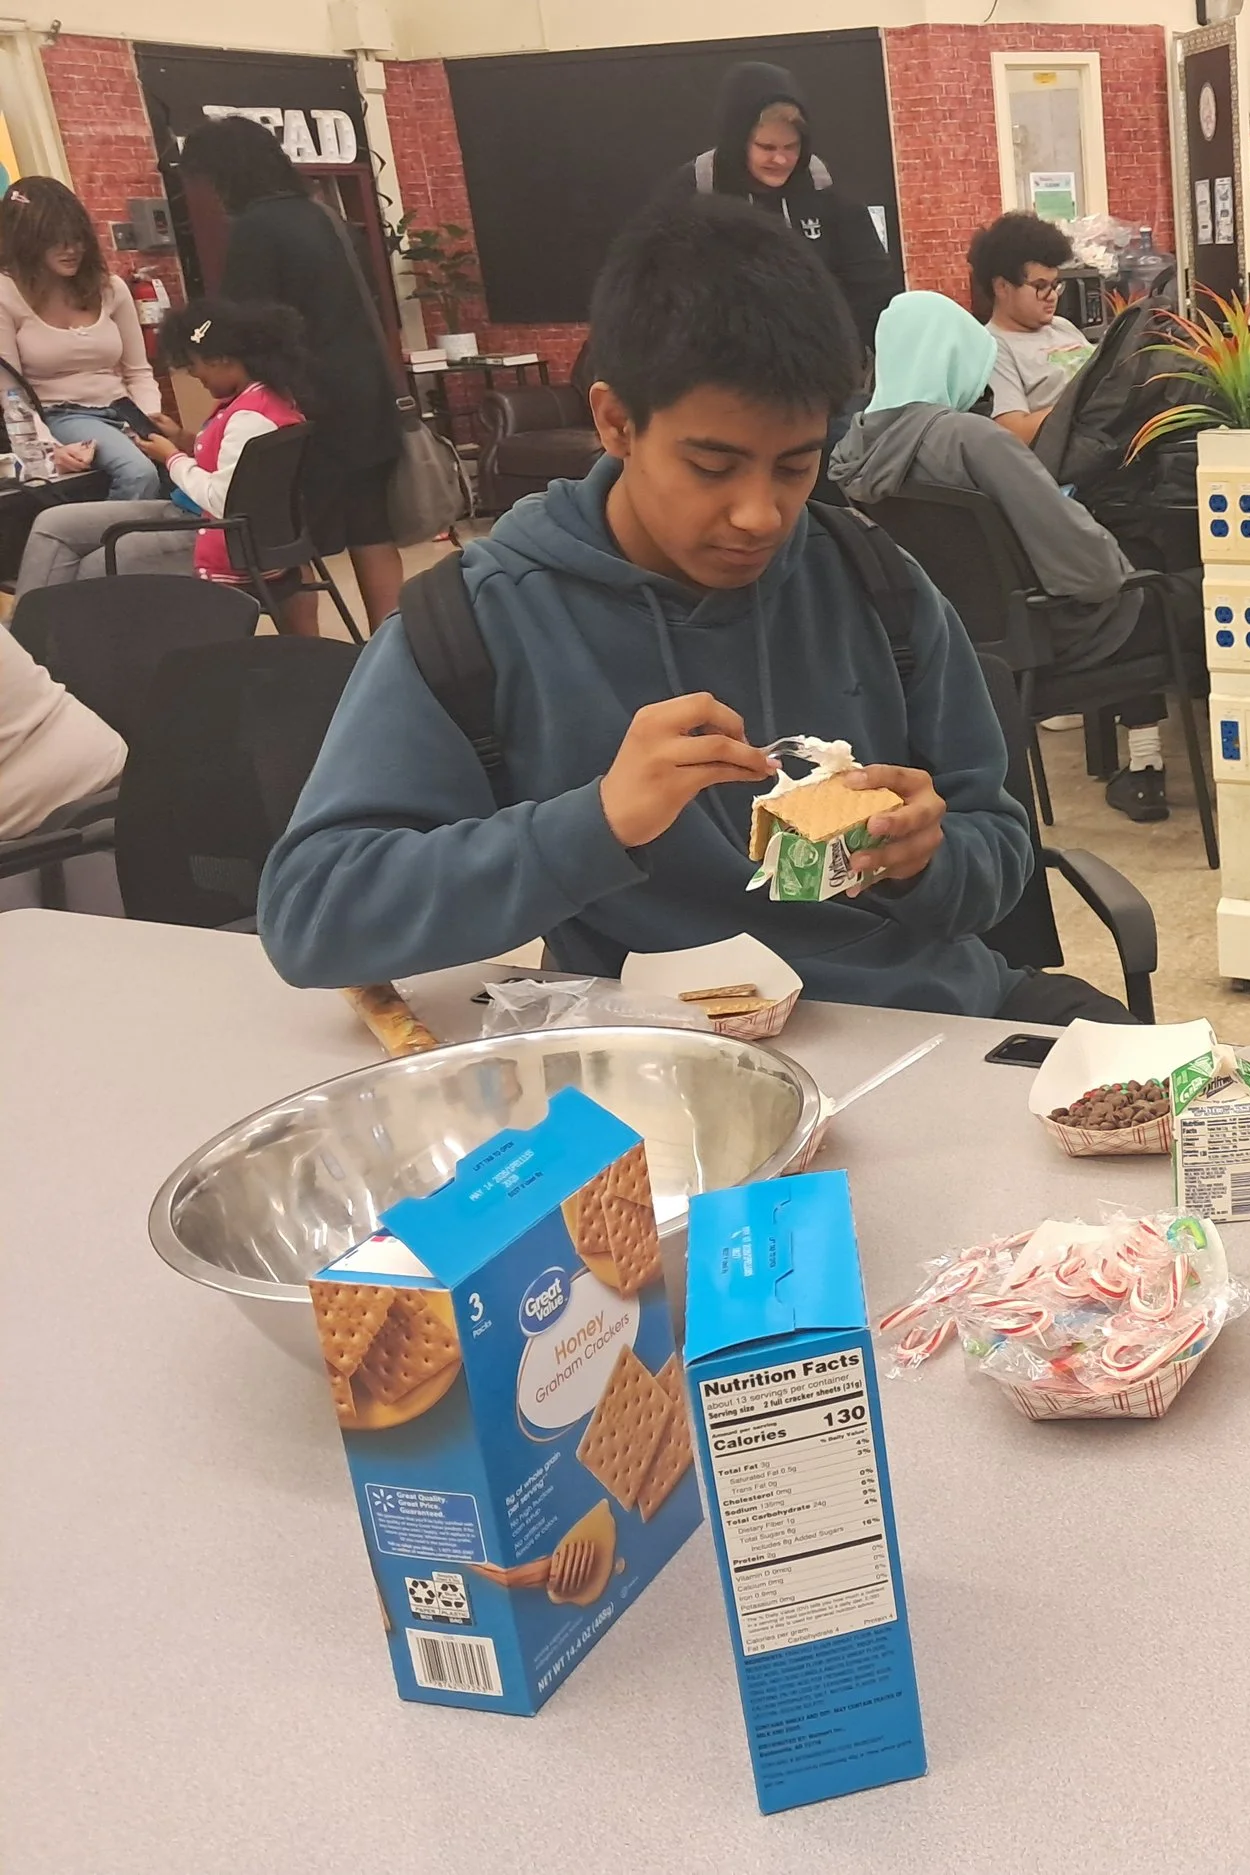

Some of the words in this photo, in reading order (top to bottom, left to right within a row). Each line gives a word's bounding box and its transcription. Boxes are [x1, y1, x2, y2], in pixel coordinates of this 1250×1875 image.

[202, 104, 357, 163] AD
[525, 1278, 562, 1317] Great
[468, 1293, 483, 1322] 3
[473, 1319, 492, 1339] Packs
[554, 1310, 604, 1364] Honey
[535, 1357, 583, 1403] Graham
[584, 1313, 629, 1360] Crackers
[704, 1368, 796, 1397] Nutrition
[802, 1354, 860, 1377] Facts
[707, 1400, 733, 1411] about
[736, 1396, 747, 1404] 13
[749, 1388, 788, 1402] servings
[791, 1384, 805, 1394] per
[808, 1374, 849, 1389] container
[708, 1409, 737, 1420] Serving
[740, 1405, 755, 1413] size
[770, 1397, 783, 1407] full
[785, 1392, 814, 1404] cracker
[816, 1386, 841, 1398] sheets
[843, 1379, 862, 1392] (31g)
[823, 1405, 866, 1427] 130
[713, 1428, 787, 1451] Calories
[828, 1435, 844, 1443] Daily
[857, 1448, 871, 1456] 3%
[523, 1468, 544, 1488] whole
[544, 1451, 561, 1472] grain
[718, 1467, 741, 1476] Total
[744, 1463, 758, 1471] Fat
[730, 1473, 765, 1484] Saturated
[767, 1469, 779, 1477] Fat
[859, 1468, 874, 1476] 0%
[861, 1478, 875, 1486] 6%
[396, 1491, 417, 1500] Great
[418, 1494, 448, 1504] Quality.
[732, 1486, 752, 1495] Trans
[723, 1491, 774, 1507] Cholesterol
[400, 1507, 445, 1518] Guaranteed.
[508, 1502, 519, 1518] per
[725, 1506, 757, 1516] Sodium
[726, 1517, 749, 1526] Total
[752, 1504, 811, 1521] Carbohydrate
[813, 1500, 826, 1508] 24g
[738, 1524, 764, 1535] Dietary
[766, 1520, 784, 1528] Fiber
[862, 1517, 880, 1526] 16%
[740, 1535, 757, 1544] Total
[760, 1529, 785, 1541] Sugars
[751, 1542, 781, 1551] Includes
[794, 1533, 816, 1543] Added
[819, 1526, 844, 1538] Sugars
[733, 1555, 765, 1566] Protein
[735, 1571, 763, 1583] Vitamin
[737, 1582, 767, 1592] Calcium
[768, 1578, 784, 1586] 0mg
[739, 1593, 753, 1601] Iron
[740, 1600, 777, 1611] Potassium
[779, 1595, 795, 1603] 0mg
[864, 1616, 887, 1625] Protein
[746, 1633, 775, 1645] Calories
[790, 1627, 809, 1636] gram
[787, 1629, 834, 1644] Carbohydrate
[537, 1670, 552, 1693] NET
[552, 1655, 565, 1676] WT
[565, 1639, 582, 1660] 14.4
[582, 1626, 592, 1643] OZ
